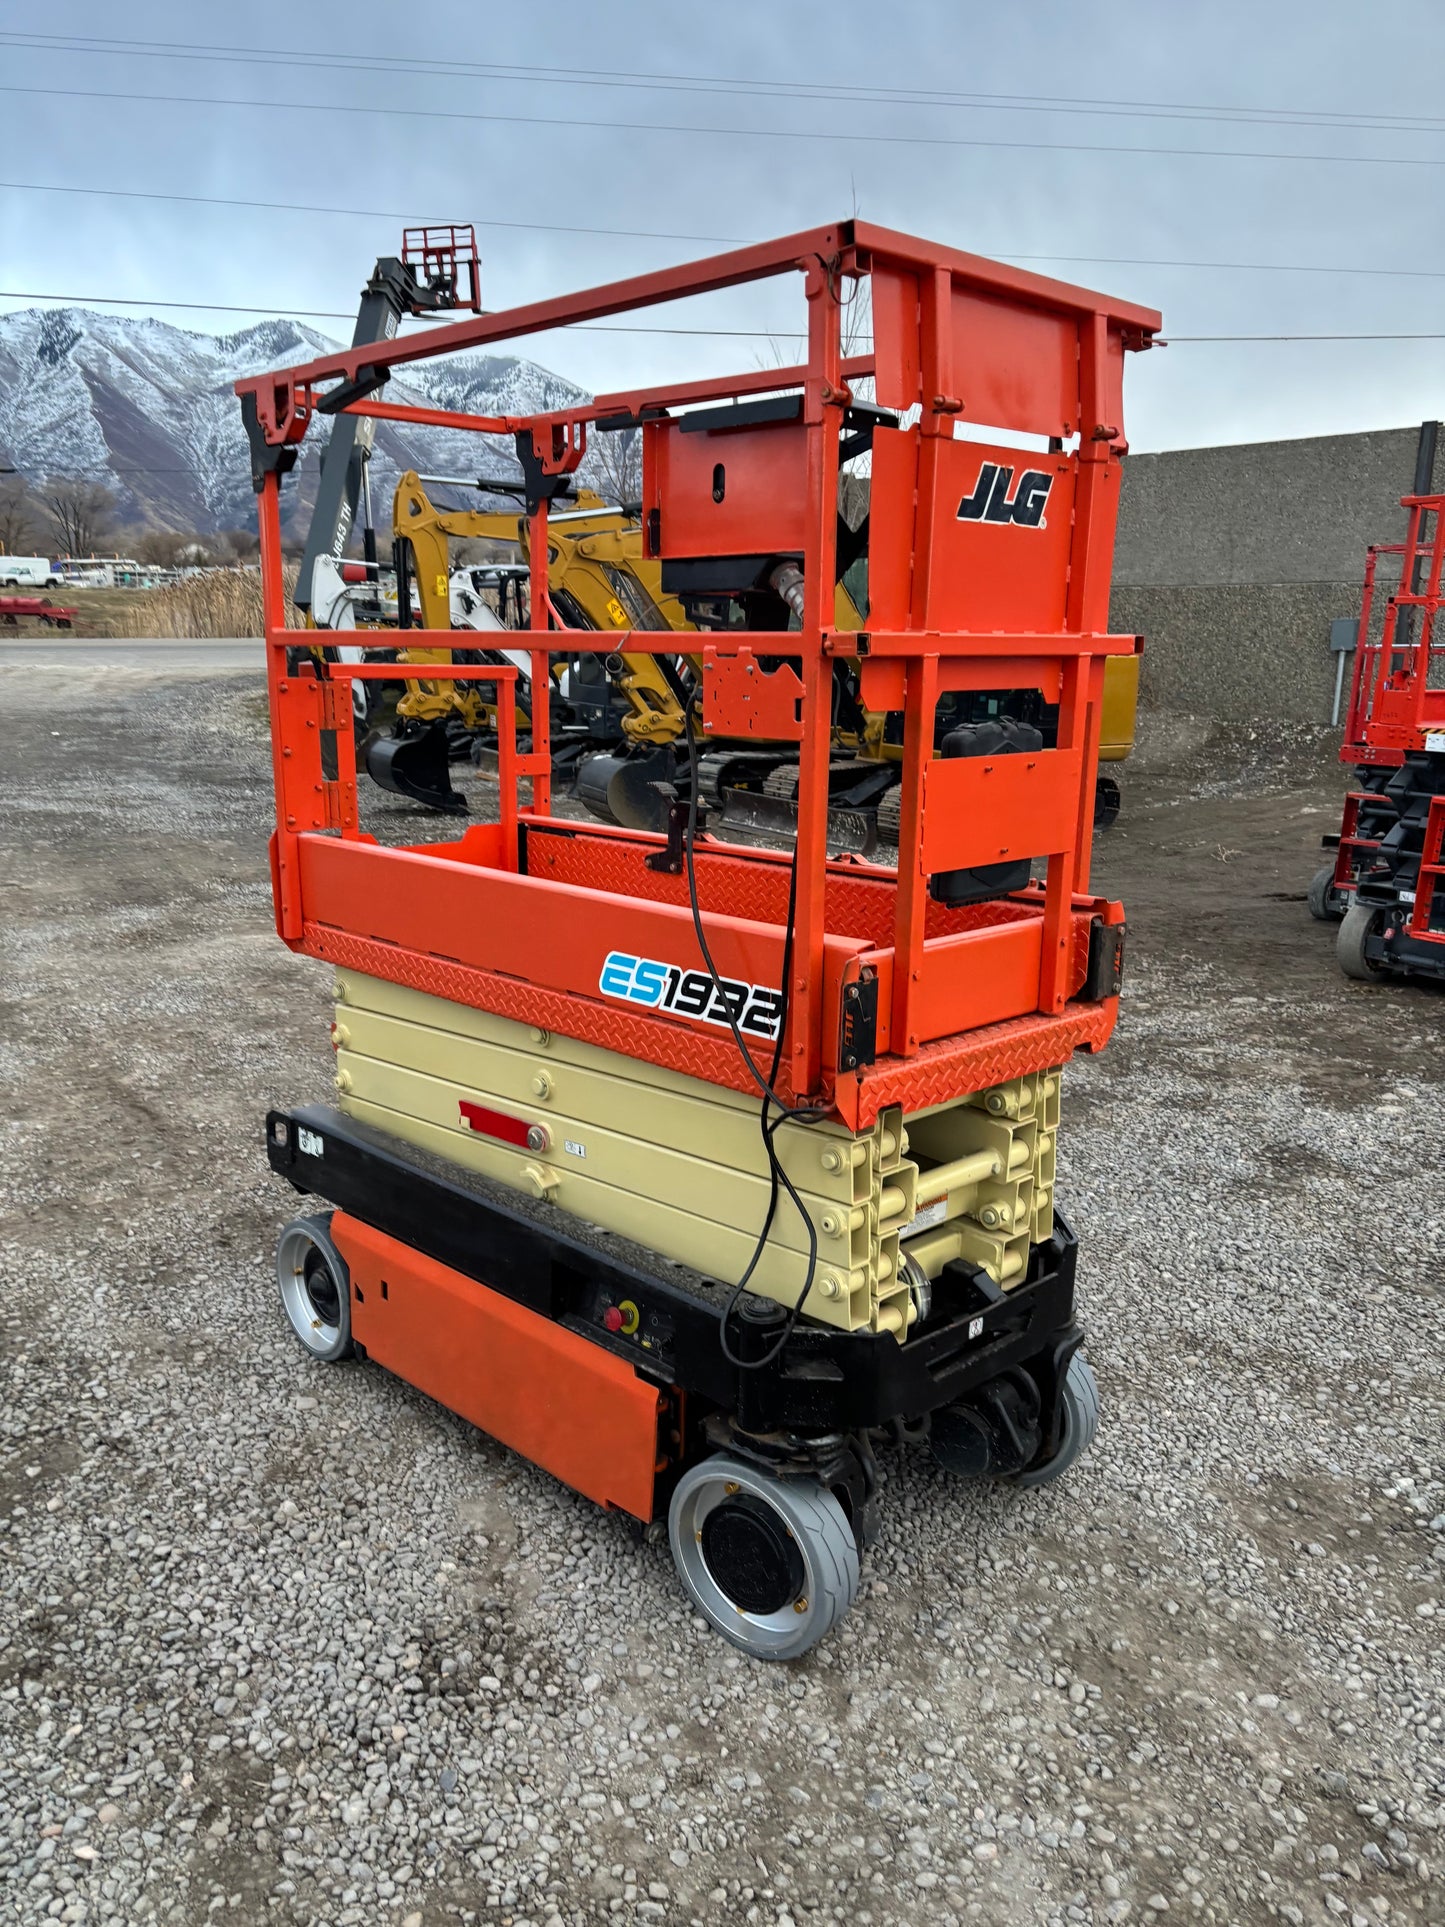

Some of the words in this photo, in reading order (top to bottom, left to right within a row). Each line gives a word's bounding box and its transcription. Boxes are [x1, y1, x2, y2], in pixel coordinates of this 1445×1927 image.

[341, 501, 352, 522] TH
[956, 461, 1054, 527] JLG
[601, 953, 786, 1038] ES1932
